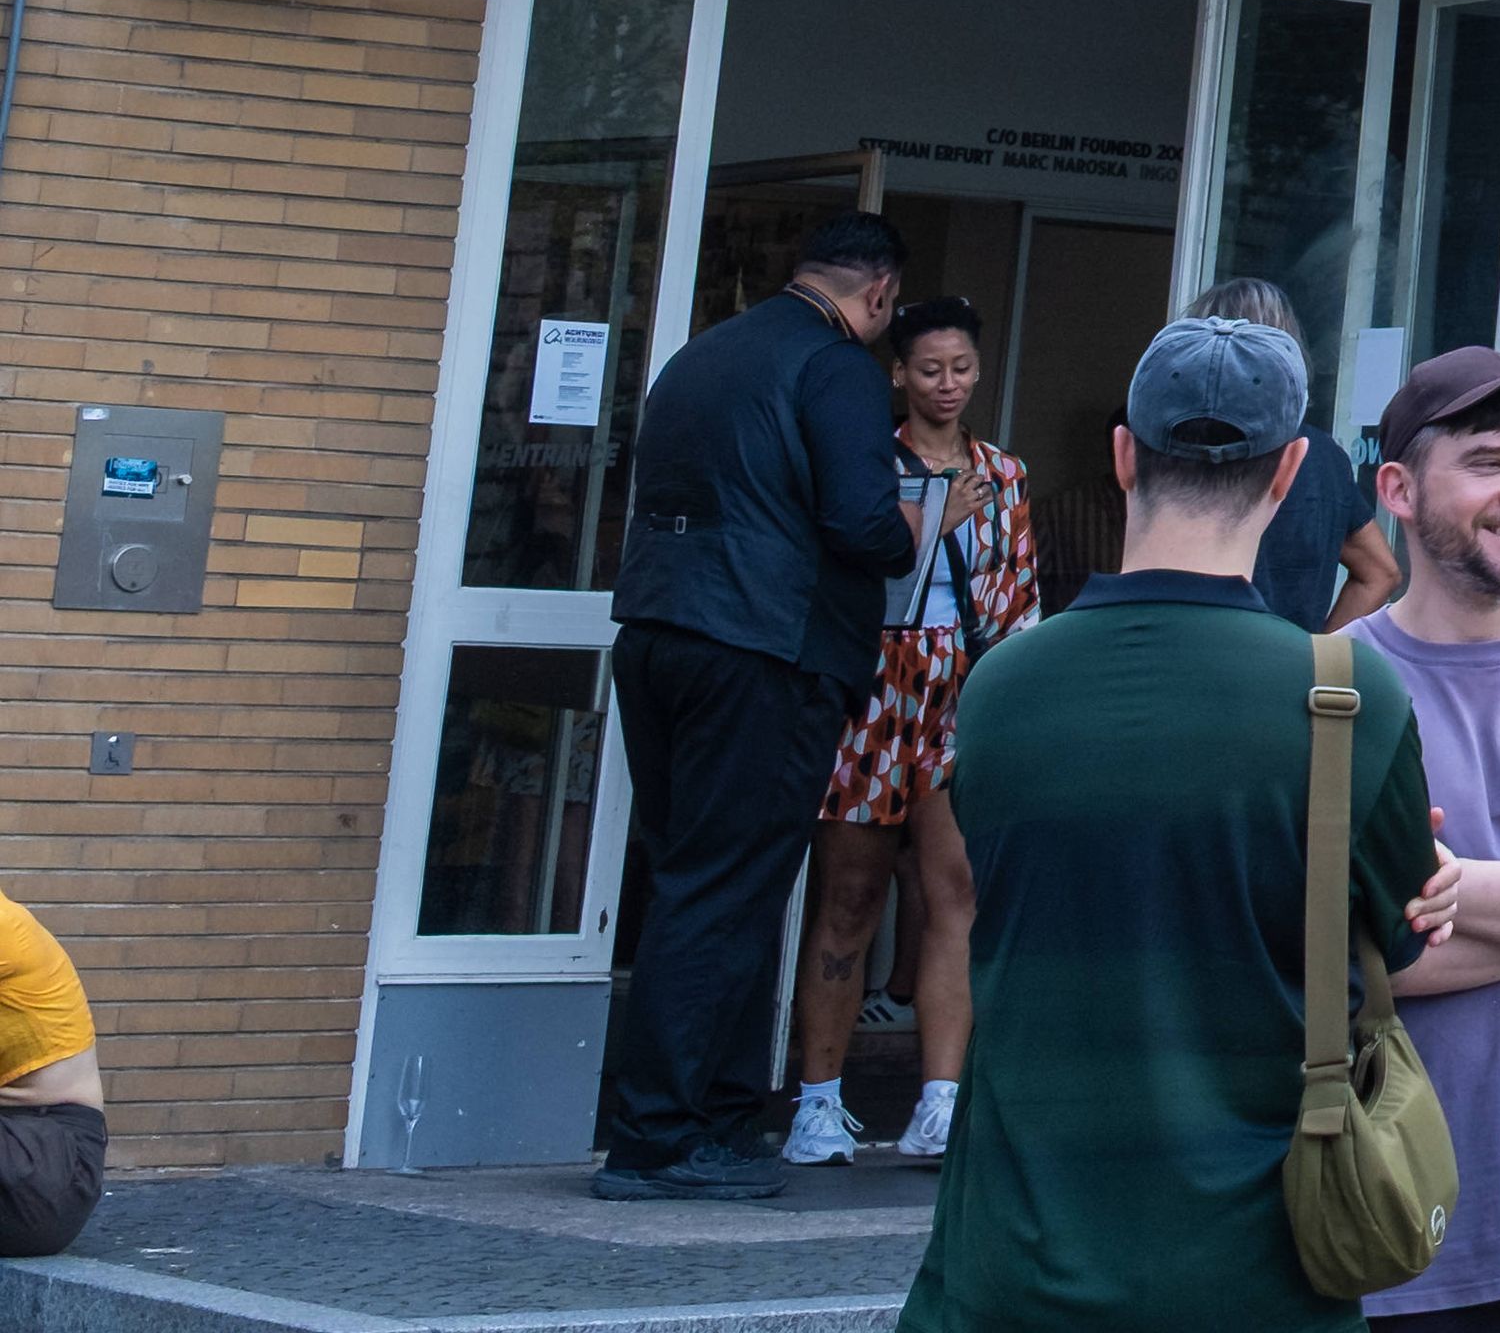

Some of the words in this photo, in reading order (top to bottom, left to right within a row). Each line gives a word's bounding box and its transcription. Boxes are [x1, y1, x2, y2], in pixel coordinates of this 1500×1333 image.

[858, 137, 931, 160] STEPHAN
[934, 144, 994, 166] ERFURT
[1003, 151, 1049, 171] MARC
[1053, 155, 1128, 179] NAROSKA
[1140, 163, 1179, 183] INGO
[1021, 132, 1076, 152] BERLIN
[1080, 136, 1153, 159] FOUNDED
[1156, 144, 1185, 163] 200
